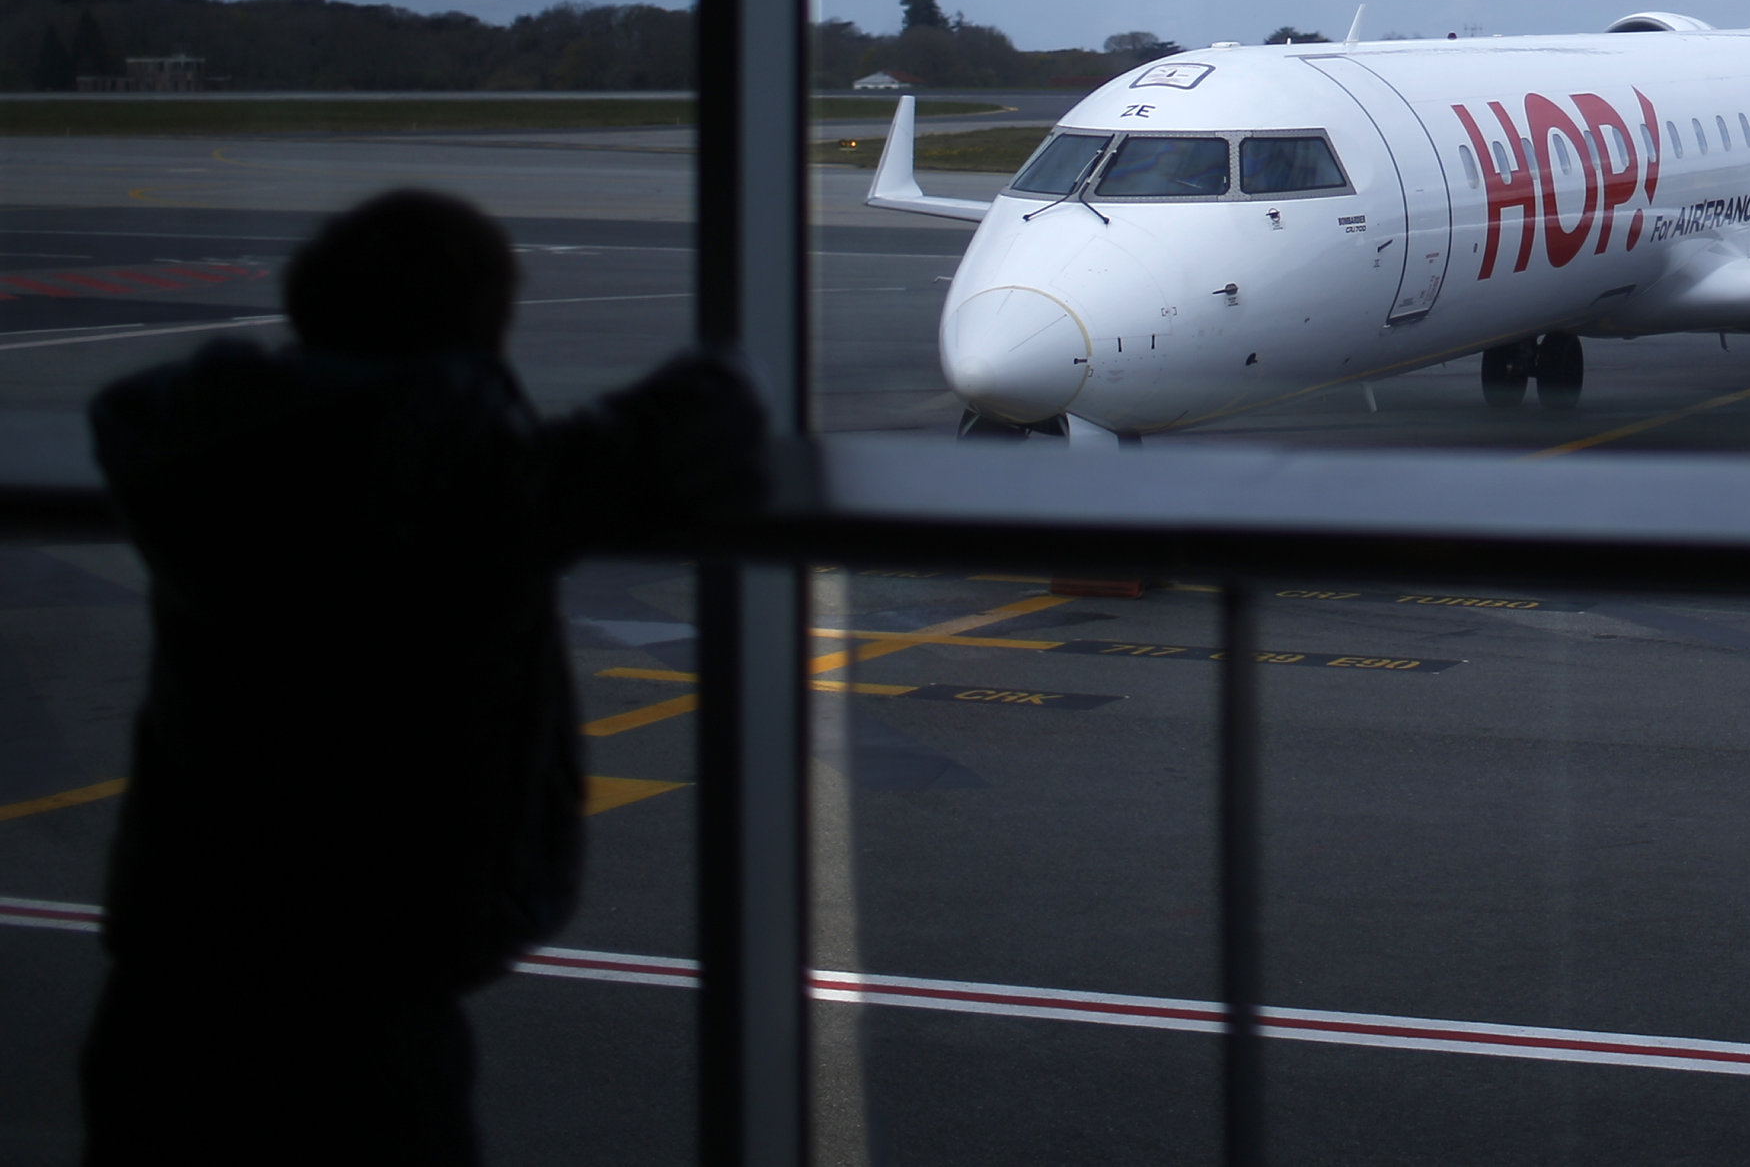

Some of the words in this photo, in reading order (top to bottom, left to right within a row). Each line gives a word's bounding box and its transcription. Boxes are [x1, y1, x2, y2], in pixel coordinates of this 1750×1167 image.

[1119, 104, 1156, 119] ZE
[1449, 84, 1661, 281] HOP!
[1649, 215, 1673, 244] For
[1395, 594, 1541, 610] TURBO
[1326, 656, 1421, 670] E90
[953, 688, 1065, 706] CRK
